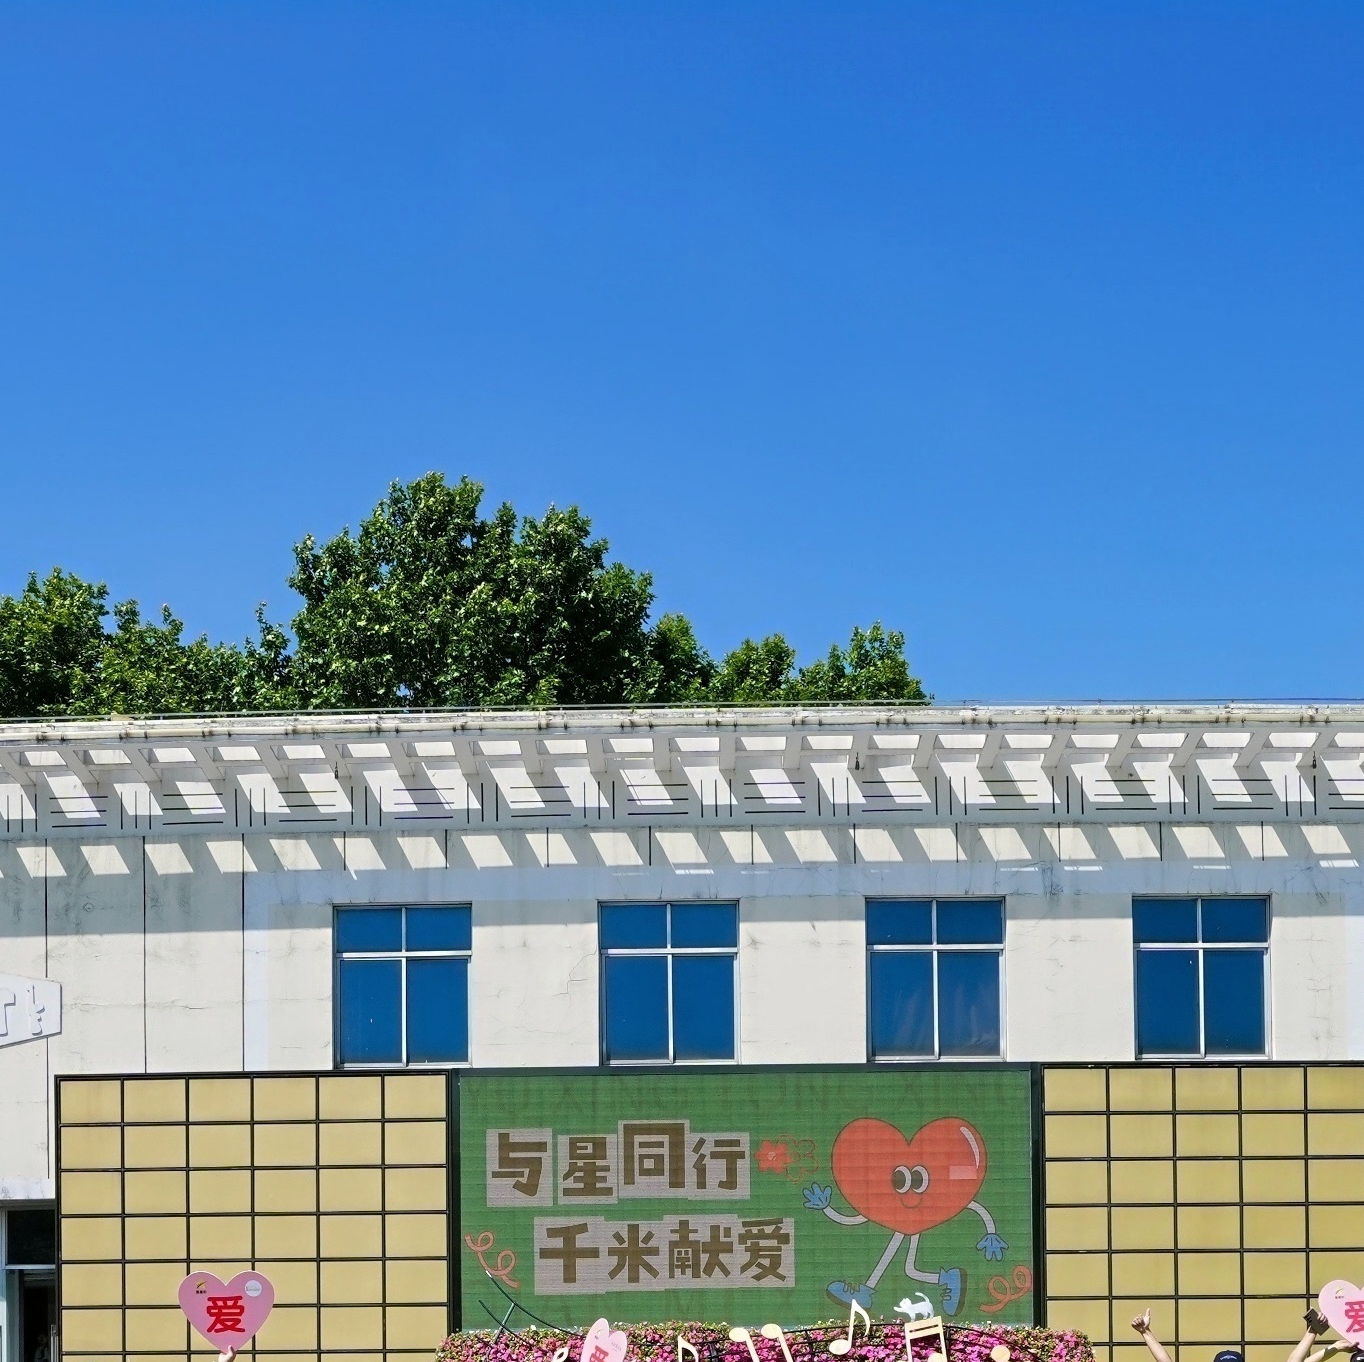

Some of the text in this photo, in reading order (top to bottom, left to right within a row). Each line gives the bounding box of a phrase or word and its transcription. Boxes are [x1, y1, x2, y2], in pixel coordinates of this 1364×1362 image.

[491, 1124, 745, 1197] 与星同行
[539, 1218, 792, 1284] 千米献爱
[205, 1294, 246, 1334] 爱
